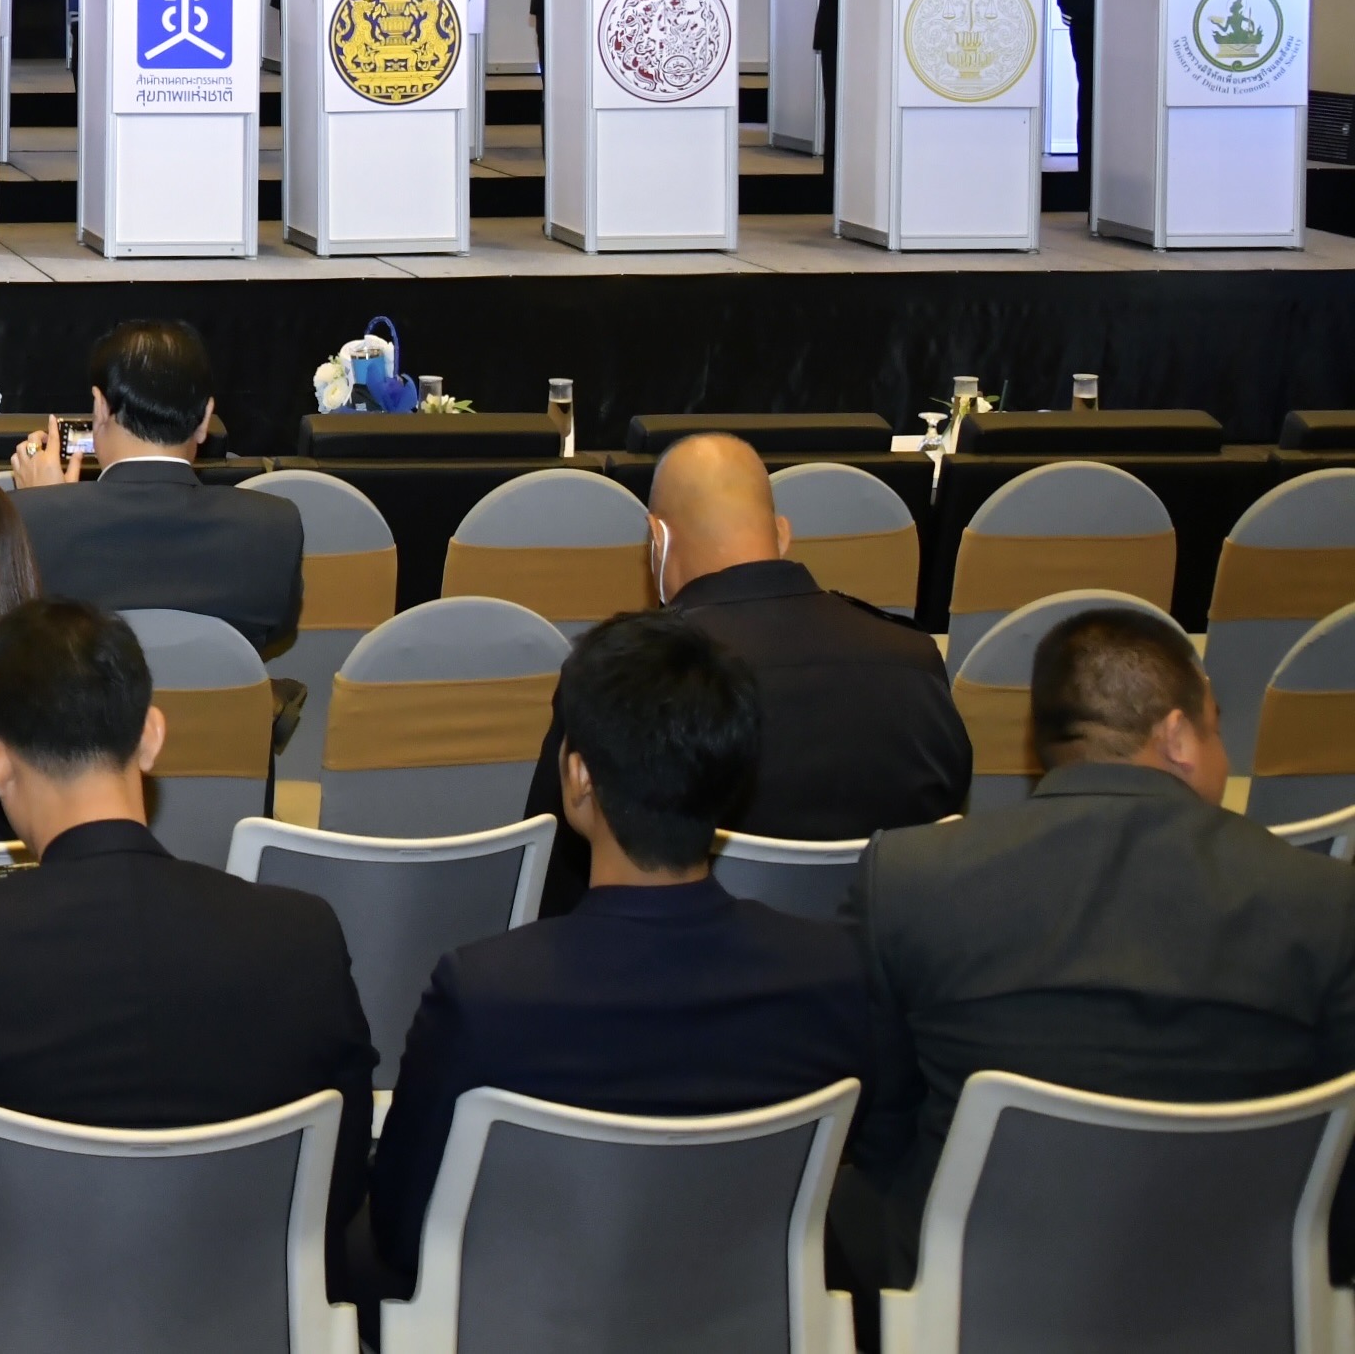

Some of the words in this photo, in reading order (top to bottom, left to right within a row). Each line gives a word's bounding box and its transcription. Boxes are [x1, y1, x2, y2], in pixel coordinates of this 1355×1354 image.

[1172, 39, 1192, 73] Ministry
[1192, 72, 1202, 82] of
[1201, 76, 1230, 94] Digital
[1233, 80, 1270, 95] Economy
[1272, 66, 1286, 82] and
[1285, 38, 1304, 66] Society
[136, 74, 233, 85] สำนักงานคณะกรรมการ
[136, 86, 233, 107] สุขภาพแห่งชาติ
